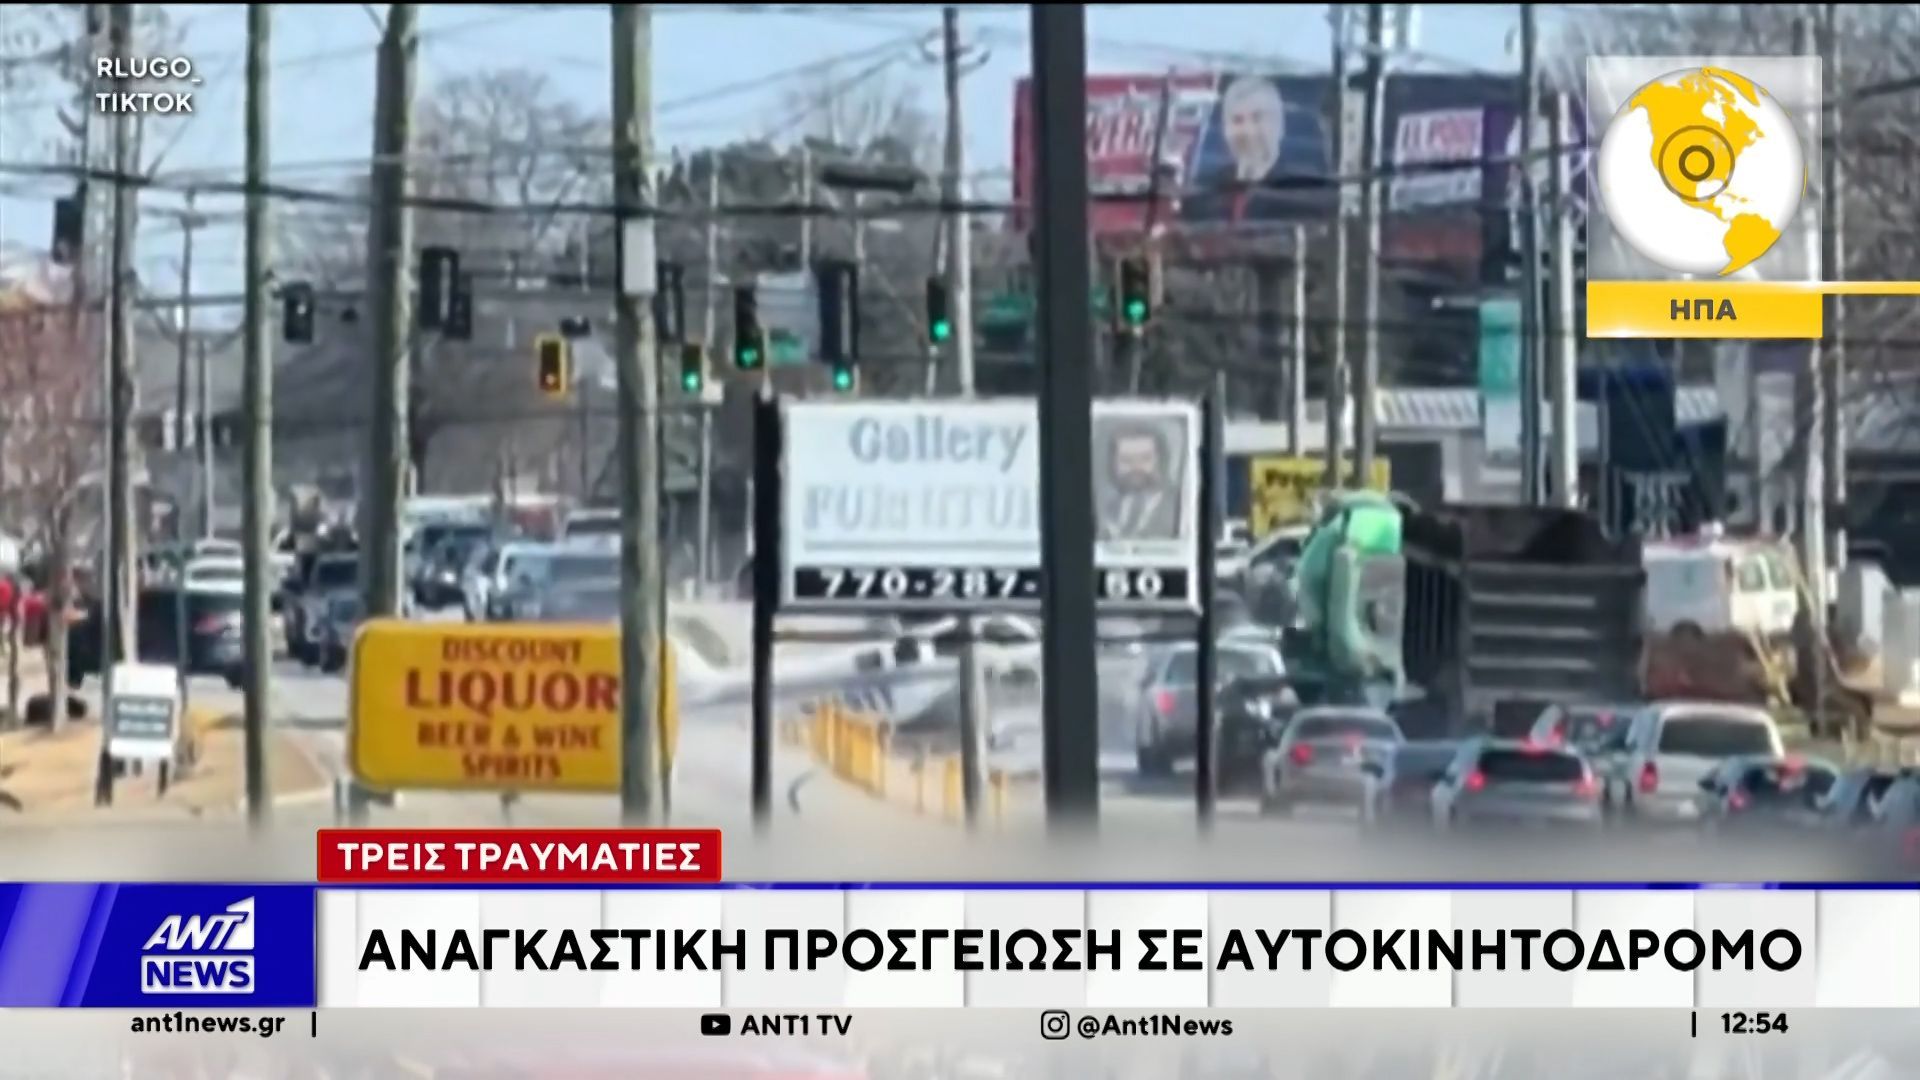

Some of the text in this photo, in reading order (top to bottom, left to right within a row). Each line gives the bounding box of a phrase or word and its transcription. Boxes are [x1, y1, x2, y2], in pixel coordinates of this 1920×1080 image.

[849, 414, 1027, 473] Gallery
[442, 636, 582, 665] DISCOUNT
[405, 667, 619, 717] LIQUOR
[417, 721, 491, 748] BEER
[533, 724, 604, 750] WINE
[462, 752, 563, 778] SPIRITS
